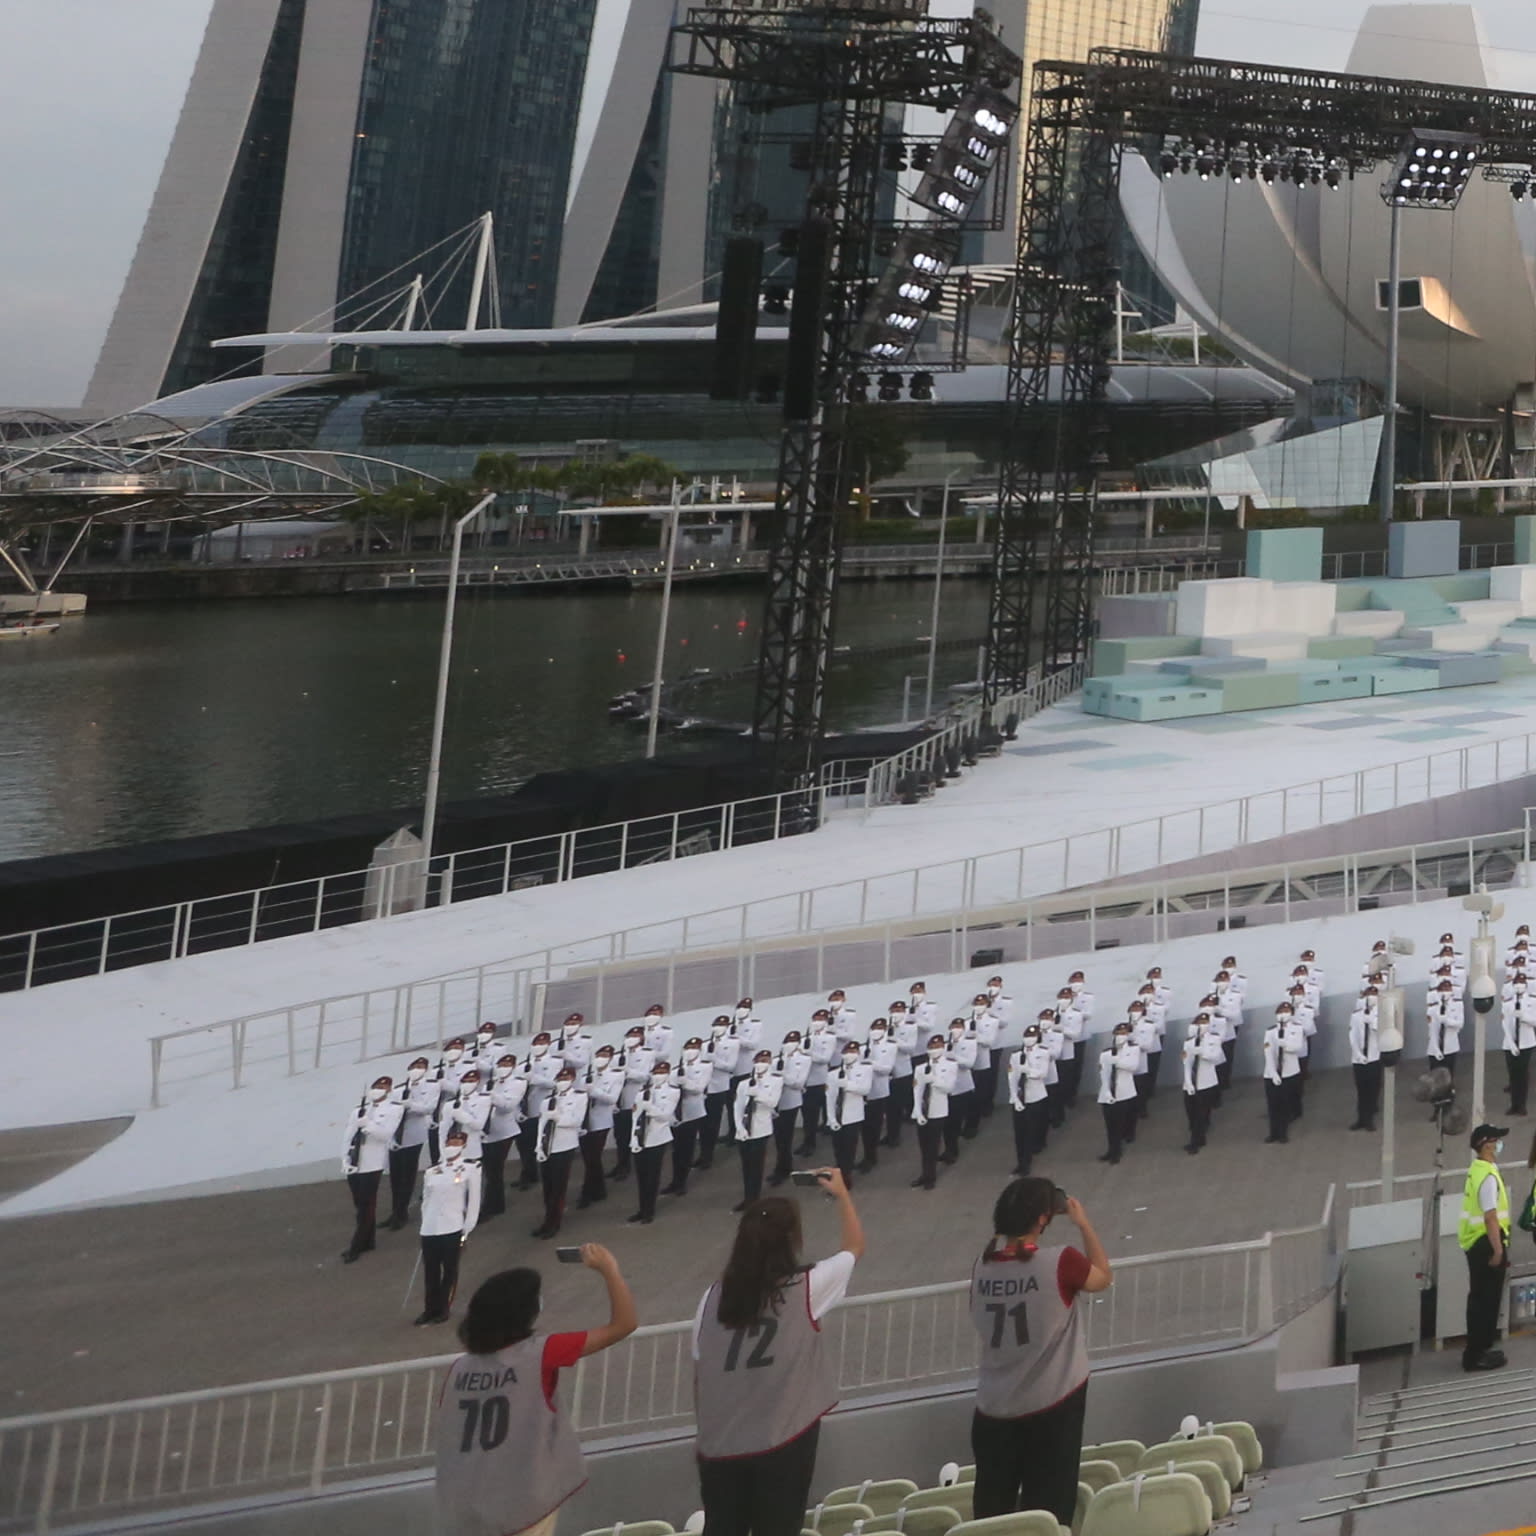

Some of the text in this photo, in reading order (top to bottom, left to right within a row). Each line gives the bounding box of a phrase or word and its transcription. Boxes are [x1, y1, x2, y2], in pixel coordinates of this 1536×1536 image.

[977, 1276, 1039, 1296] MEDIA
[723, 1317, 778, 1372] 72
[985, 1301, 1030, 1349] 71
[455, 1367, 518, 1391] MEDIA
[458, 1395, 510, 1453] 70
